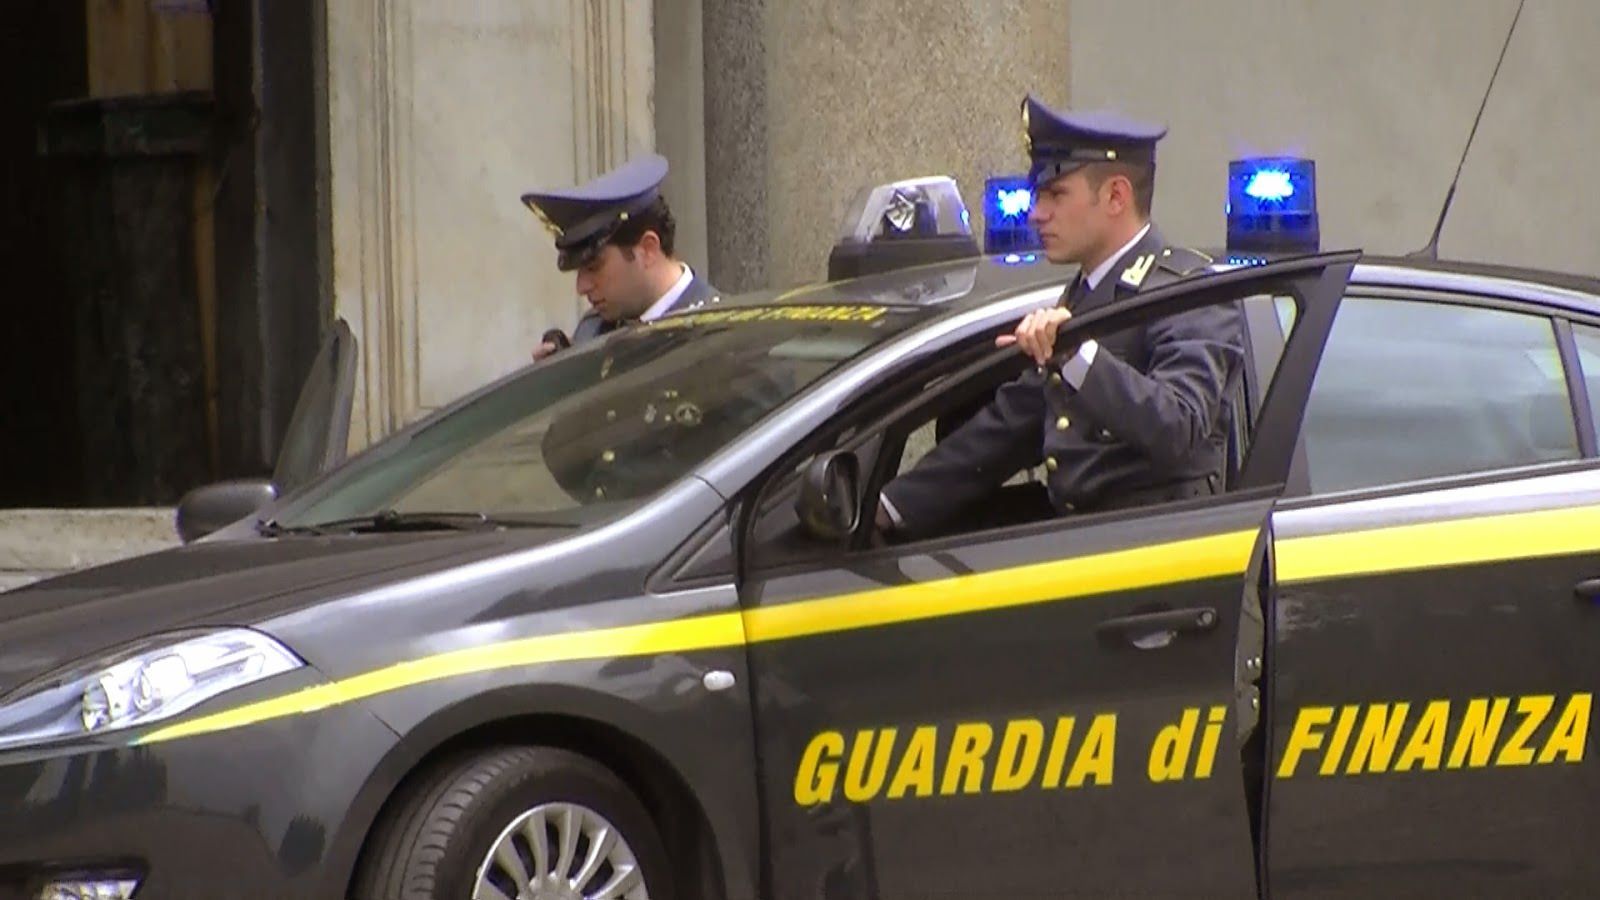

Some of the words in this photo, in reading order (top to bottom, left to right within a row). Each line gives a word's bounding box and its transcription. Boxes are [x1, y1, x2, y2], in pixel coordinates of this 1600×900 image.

[794, 713, 1117, 807] GUARDIA
[1148, 706, 1227, 783] di
[1276, 693, 1592, 779] FINANZA
